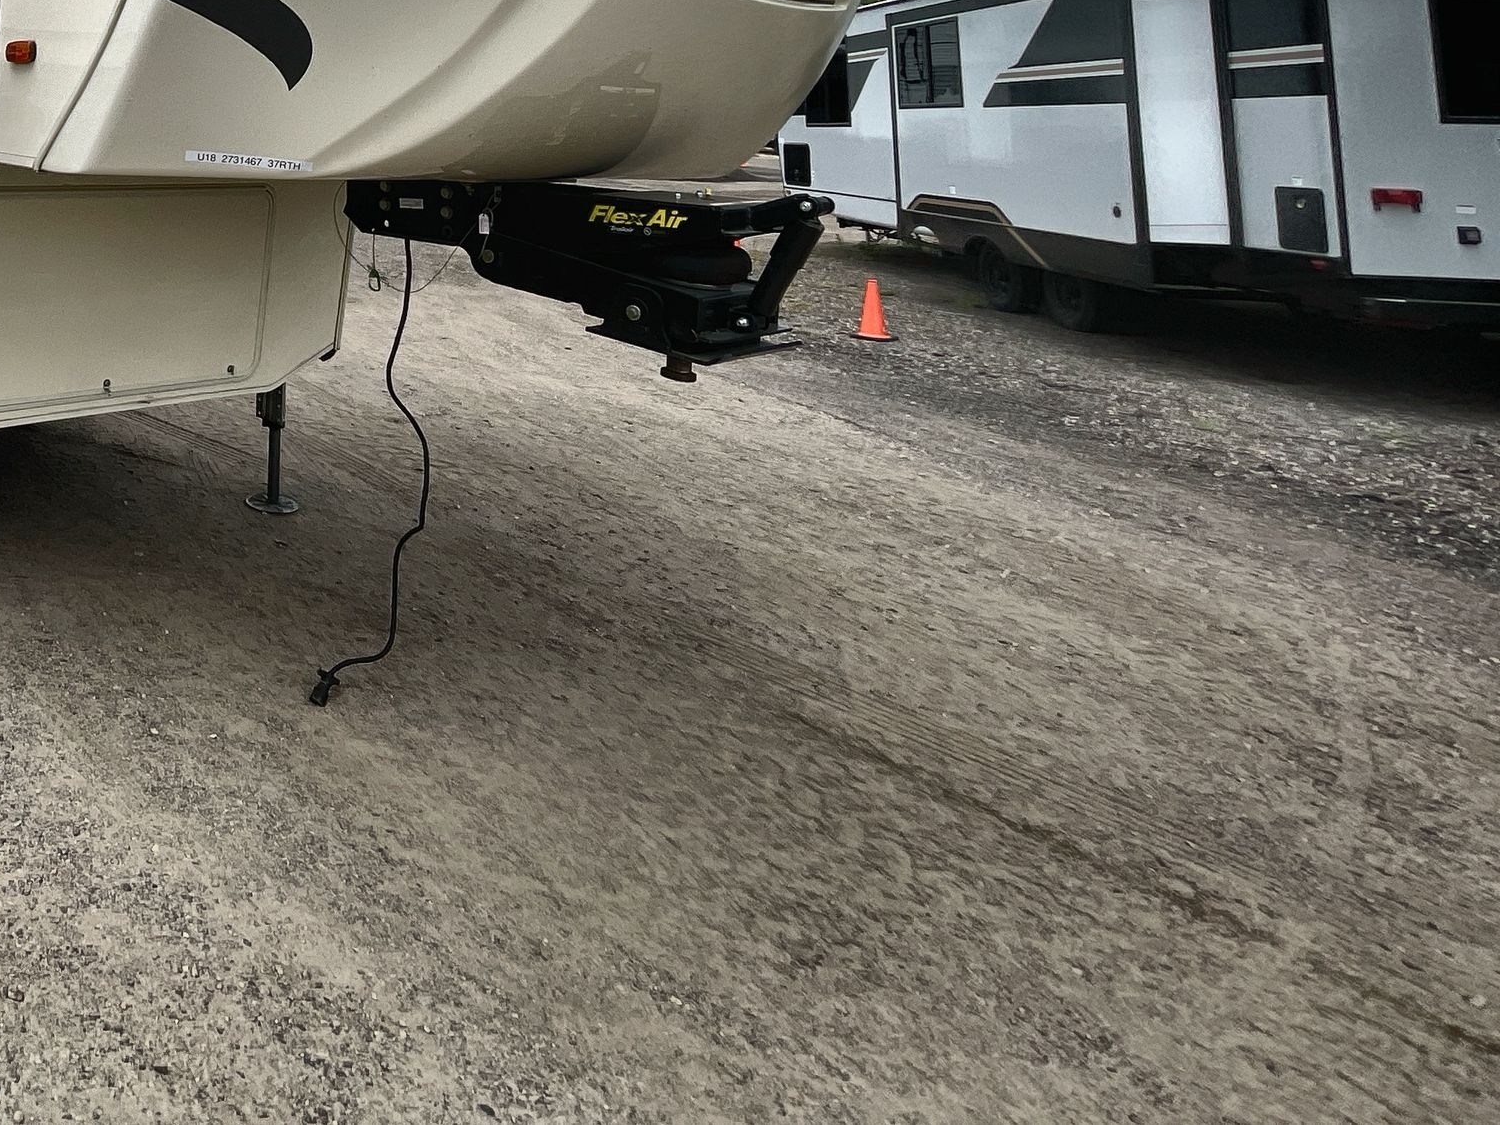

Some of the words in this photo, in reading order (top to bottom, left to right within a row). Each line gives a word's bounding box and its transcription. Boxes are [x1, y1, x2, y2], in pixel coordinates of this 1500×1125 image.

[197, 153, 216, 162] U18
[221, 155, 262, 166] 2731467
[267, 159, 301, 170] 37RTH
[588, 205, 647, 226] Flex
[646, 209, 688, 228] Air
